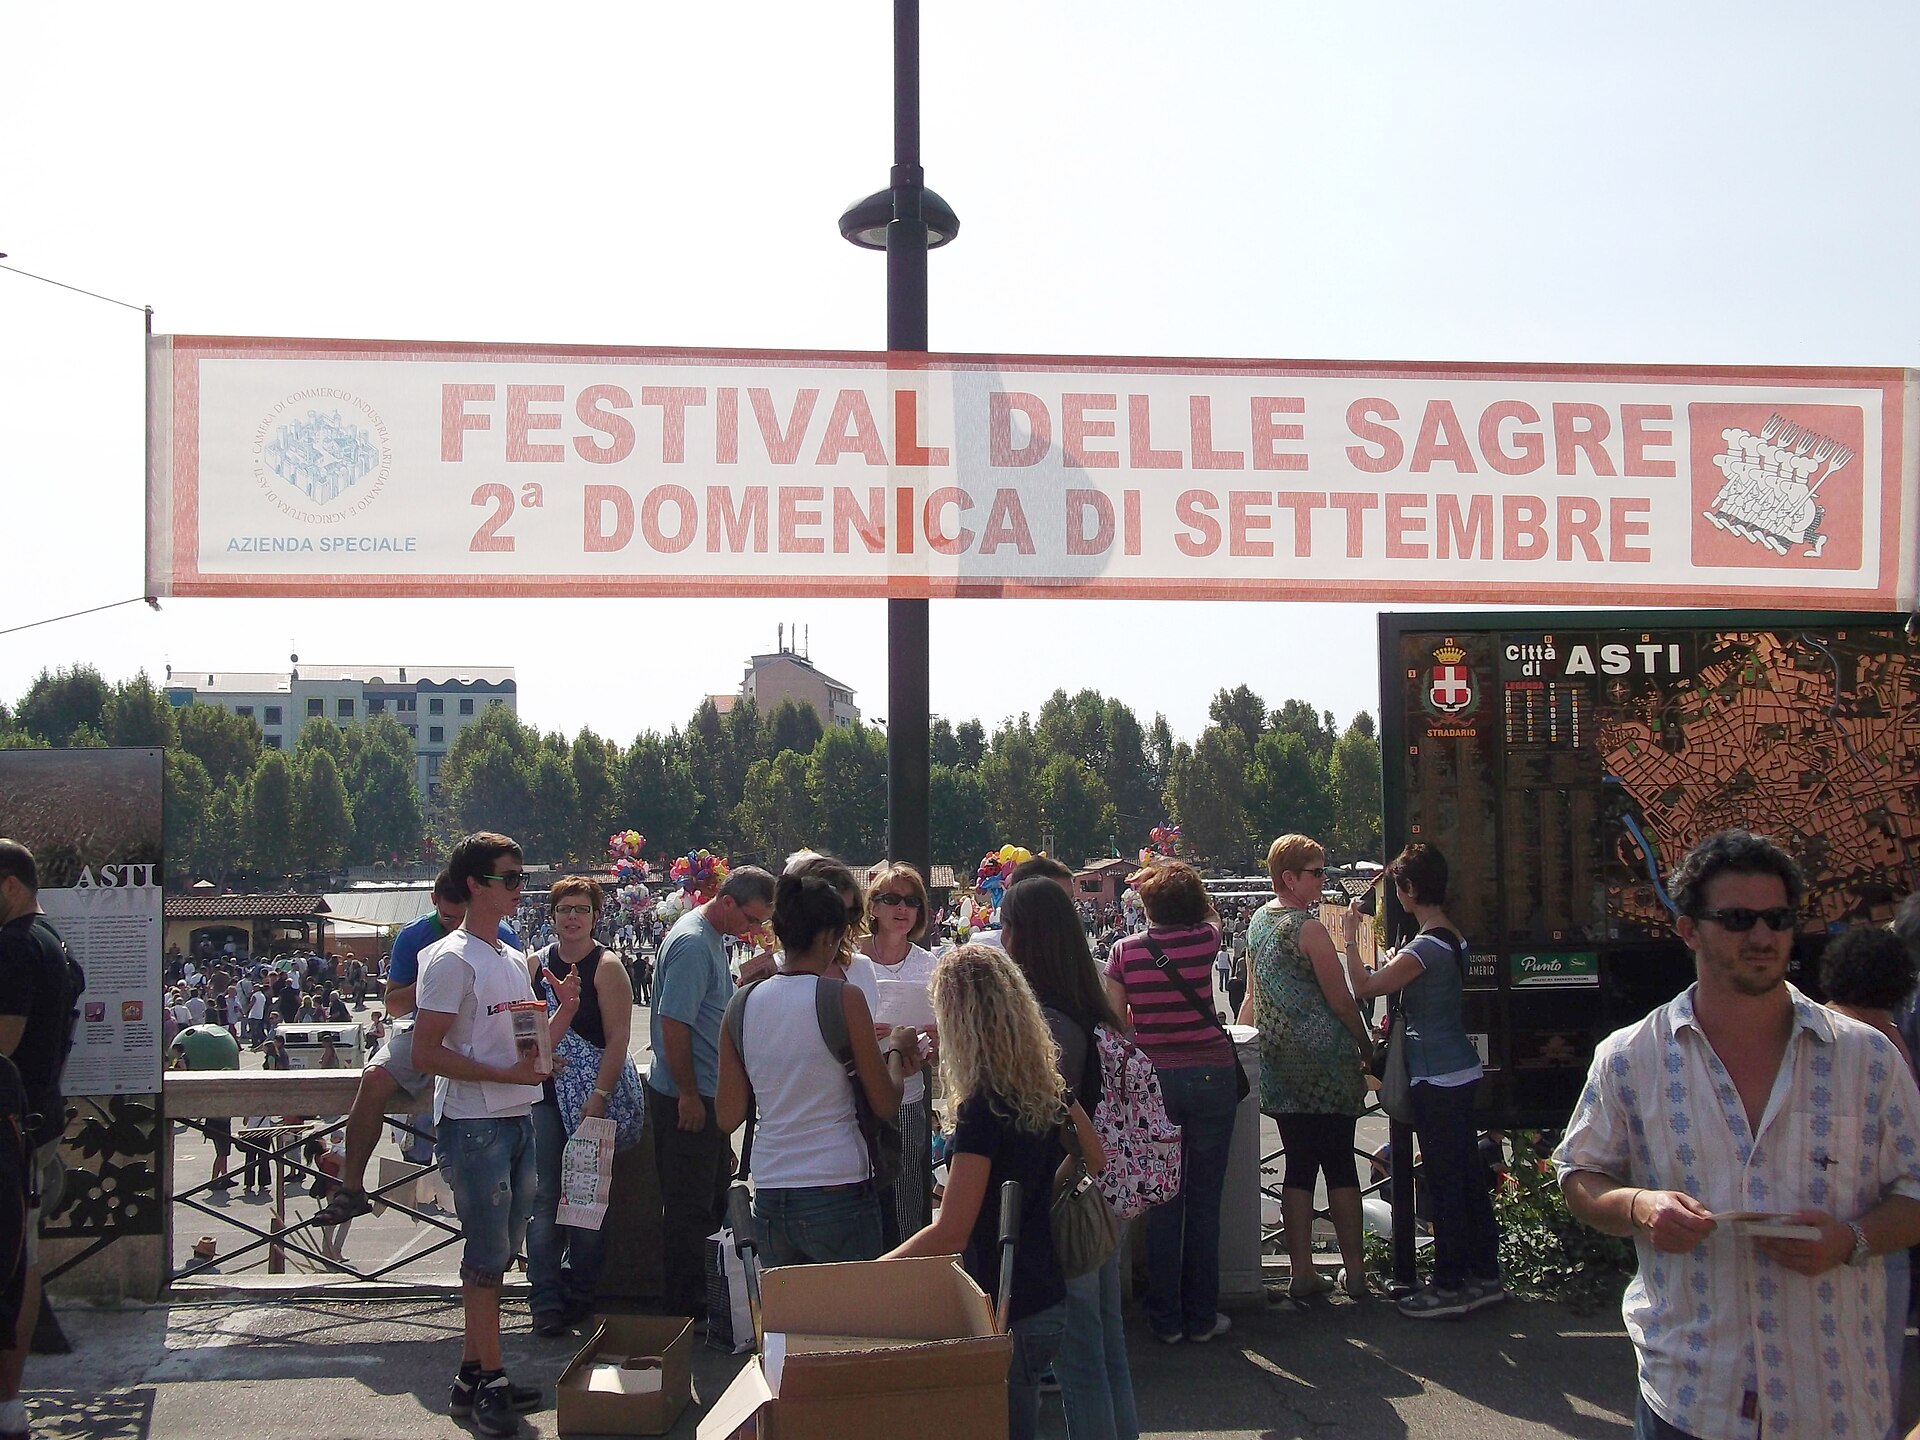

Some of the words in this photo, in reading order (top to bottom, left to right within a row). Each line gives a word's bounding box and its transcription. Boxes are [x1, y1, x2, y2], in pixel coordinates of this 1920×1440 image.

[287, 388, 352, 405] COMMERCIO
[274, 401, 286, 414] DI
[352, 397, 390, 444] INDUSTRIA
[253, 412, 276, 454] CAMERA
[440, 383, 950, 467] FESTIVAL
[989, 391, 1310, 471] DELLE
[1344, 395, 1677, 479] SAGRE
[254, 468, 270, 490] ASTI
[358, 446, 392, 510] ARTIGIANATO
[265, 490, 278, 503] DI
[277, 499, 346, 524] AGRICOLTURA
[583, 485, 1037, 556] DOMENICA
[1066, 488, 1142, 556] DI
[1173, 490, 1652, 565] SETTEMBRE
[226, 537, 313, 552] AZIENDA
[319, 537, 417, 552] SPECIALE
[1505, 644, 1556, 661] Città
[1565, 644, 1680, 675] ASTI
[1522, 661, 1541, 676] di
[1427, 729, 1476, 738] STRADARIO
[72, 863, 157, 889] ASTI
[1468, 965, 1495, 976] AMERIO
[1521, 956, 1562, 972] Punto
